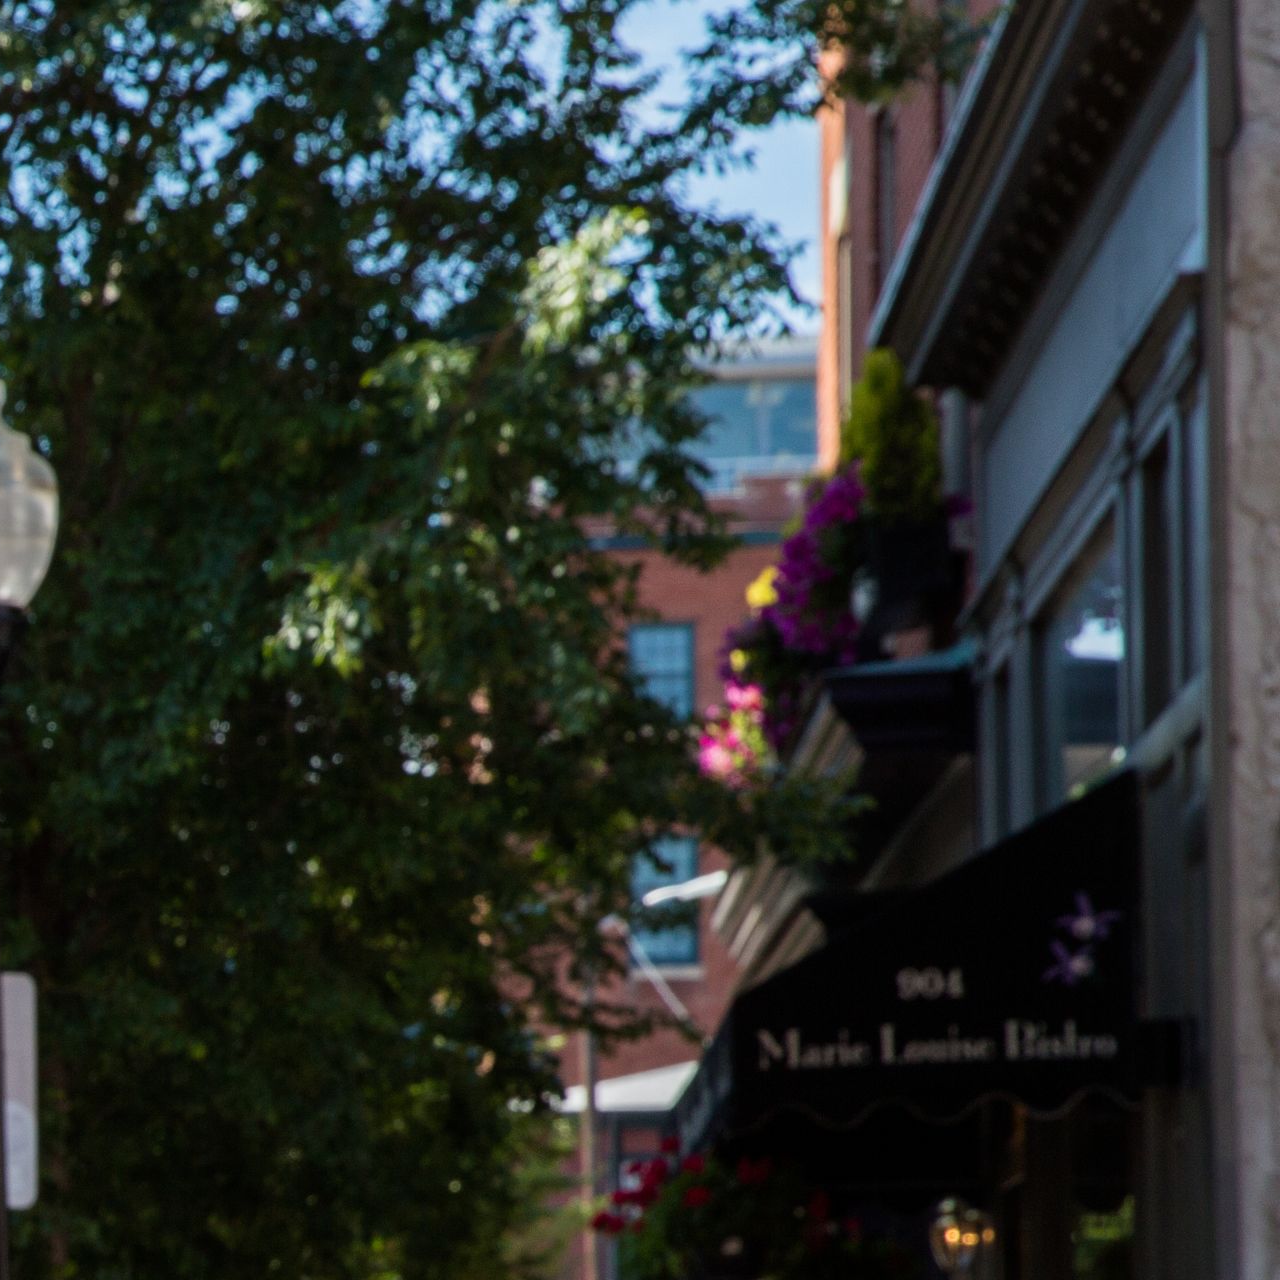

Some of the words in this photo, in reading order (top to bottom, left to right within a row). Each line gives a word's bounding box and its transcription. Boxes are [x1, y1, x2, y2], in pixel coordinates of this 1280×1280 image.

[897, 968, 964, 1001] 904
[756, 1027, 870, 1071] Marie
[880, 1021, 993, 1063] Louise
[1005, 1018, 1118, 1059] Bistro
